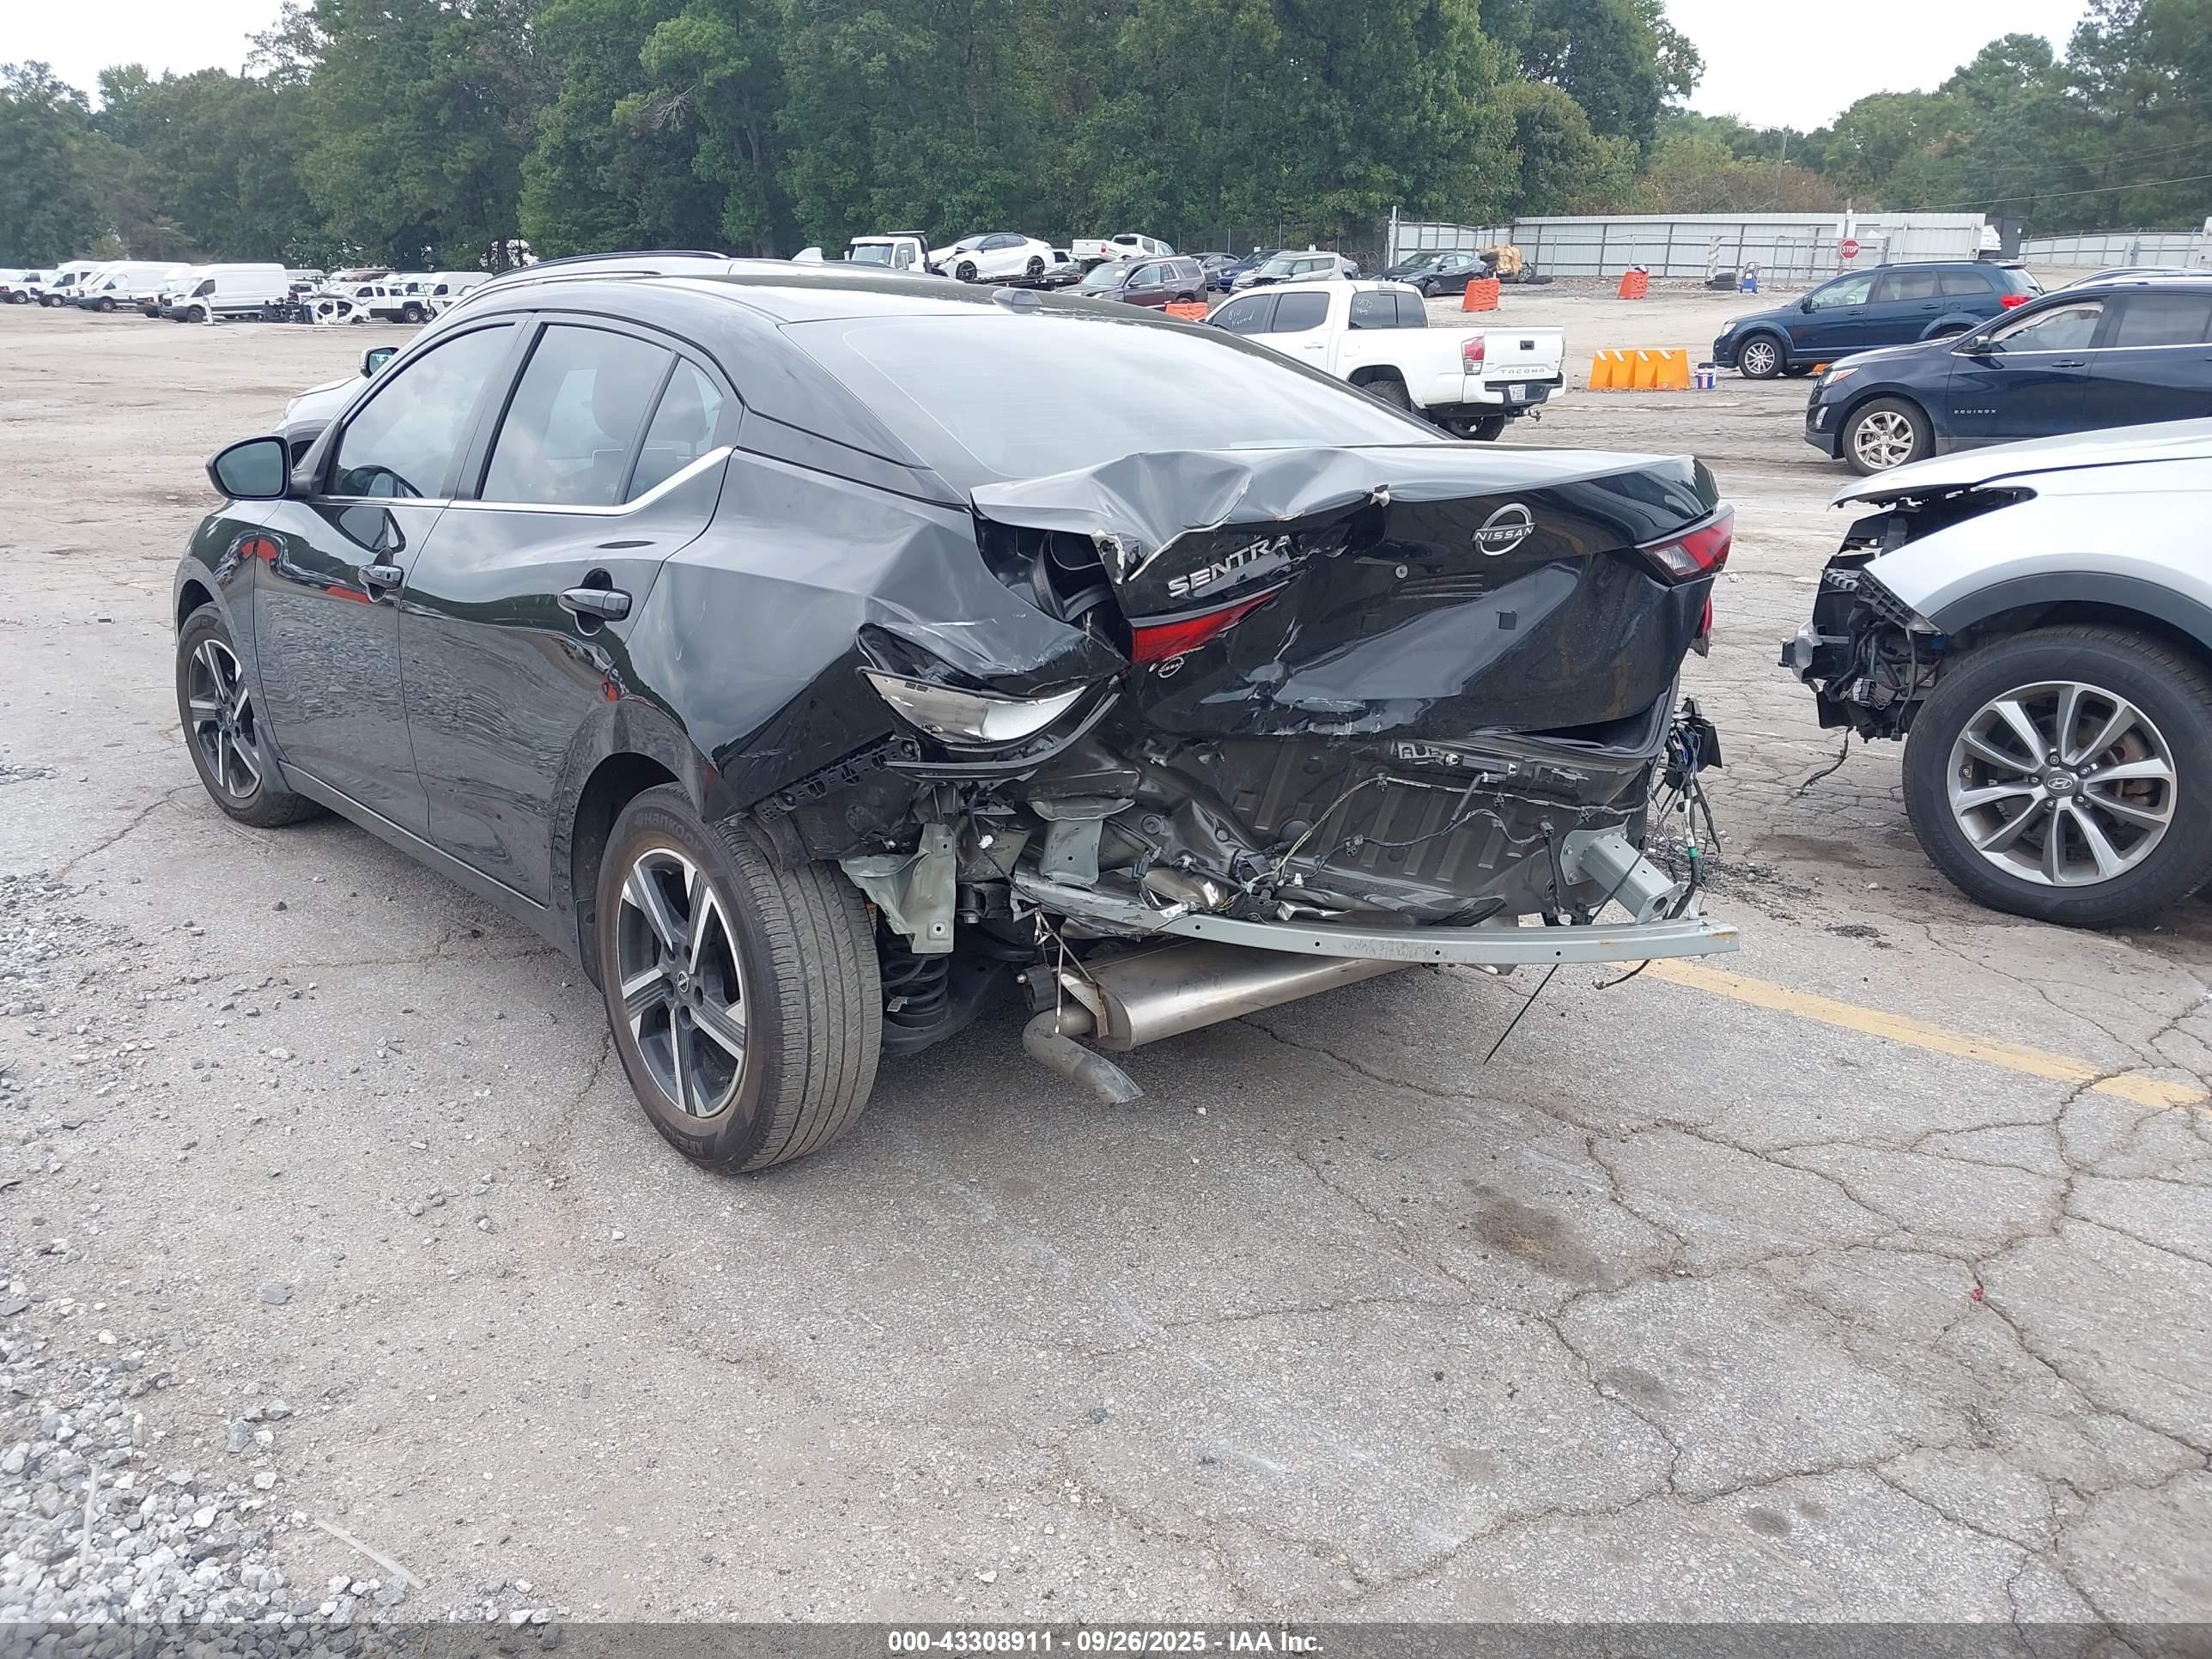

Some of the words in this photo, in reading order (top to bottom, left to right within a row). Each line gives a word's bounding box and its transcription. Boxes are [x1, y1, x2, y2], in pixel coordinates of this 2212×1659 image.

[1841, 246, 1859, 254] STOP
[1474, 525, 1535, 541] NISSAN
[1166, 534, 1293, 598] SENTRA
